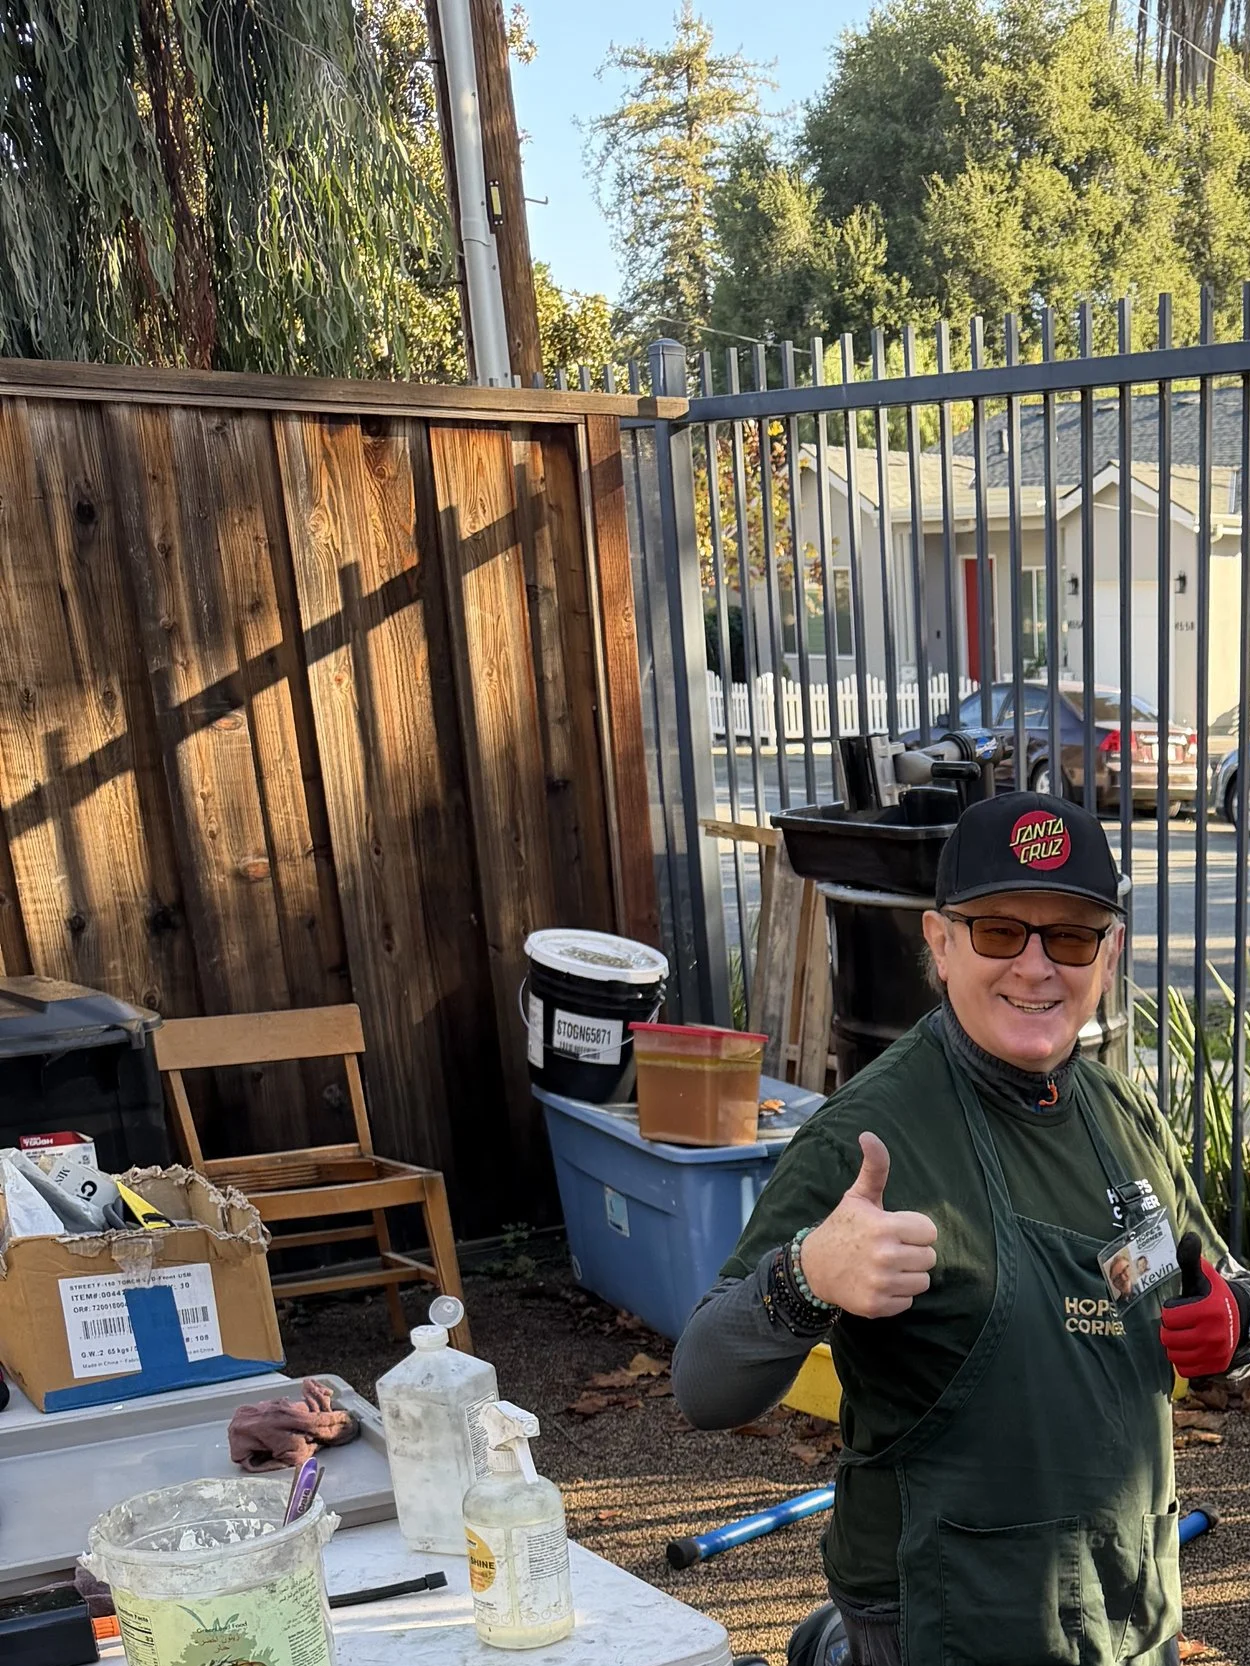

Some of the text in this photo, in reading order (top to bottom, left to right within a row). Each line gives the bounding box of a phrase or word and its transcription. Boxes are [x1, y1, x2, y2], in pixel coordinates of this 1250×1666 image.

[1009, 817, 1064, 847] SANTA
[1020, 839, 1063, 864] CRUZ
[1140, 1262, 1175, 1290] Kevin
[470, 1558, 496, 1570] SHINE
